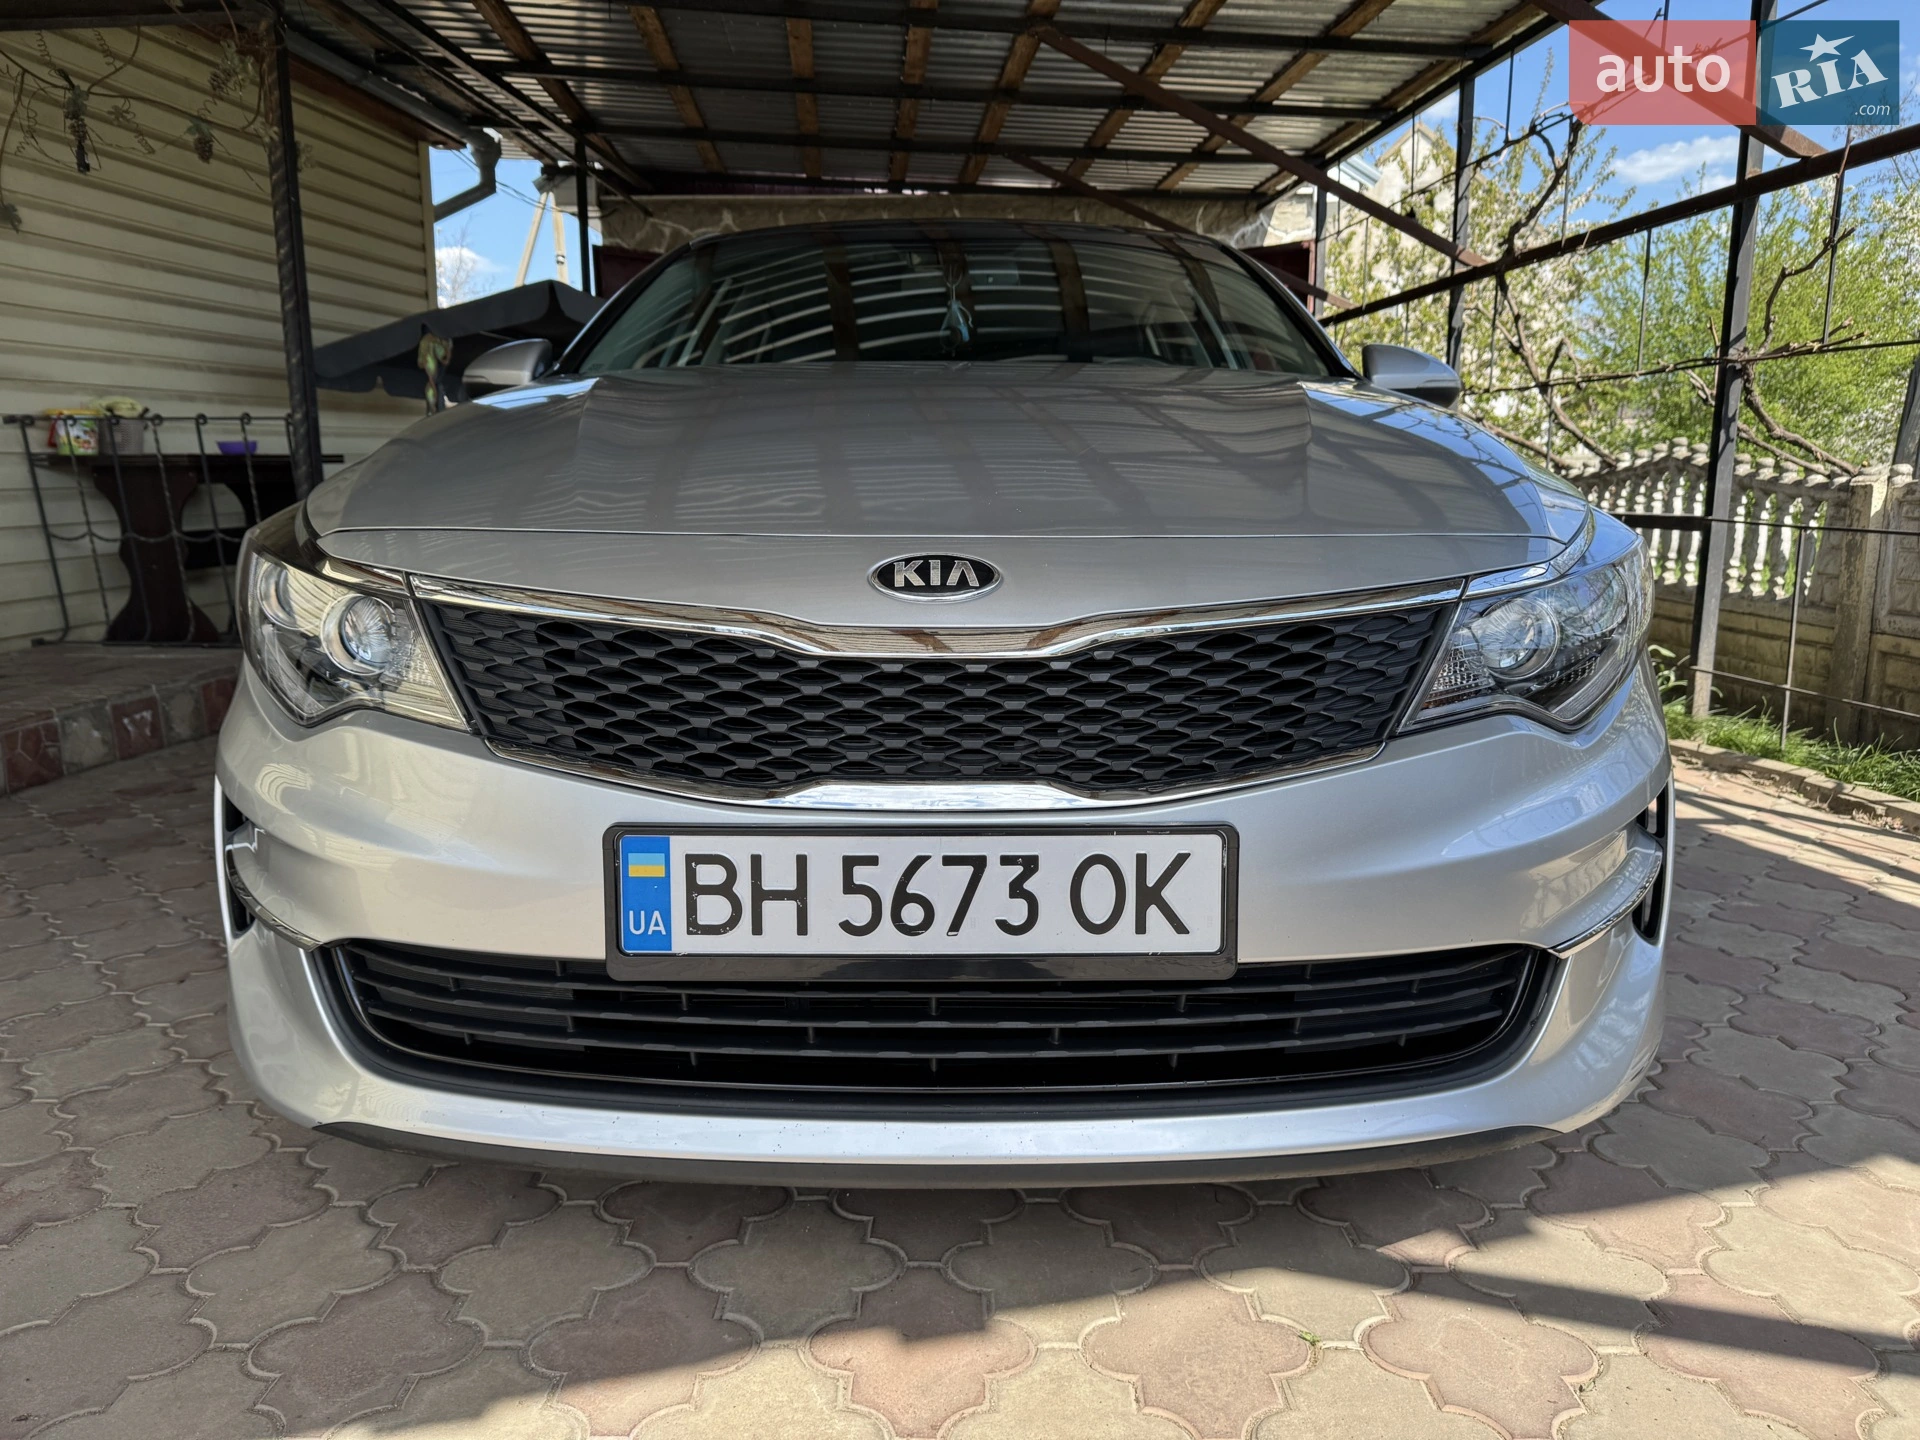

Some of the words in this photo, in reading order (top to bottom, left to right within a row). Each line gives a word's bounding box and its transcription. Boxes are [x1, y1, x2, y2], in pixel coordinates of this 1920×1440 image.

[893, 559, 980, 588] KIA
[684, 853, 808, 936] BH
[838, 854, 1039, 936] 5673
[1069, 852, 1191, 935] OK
[628, 909, 667, 936] UA
